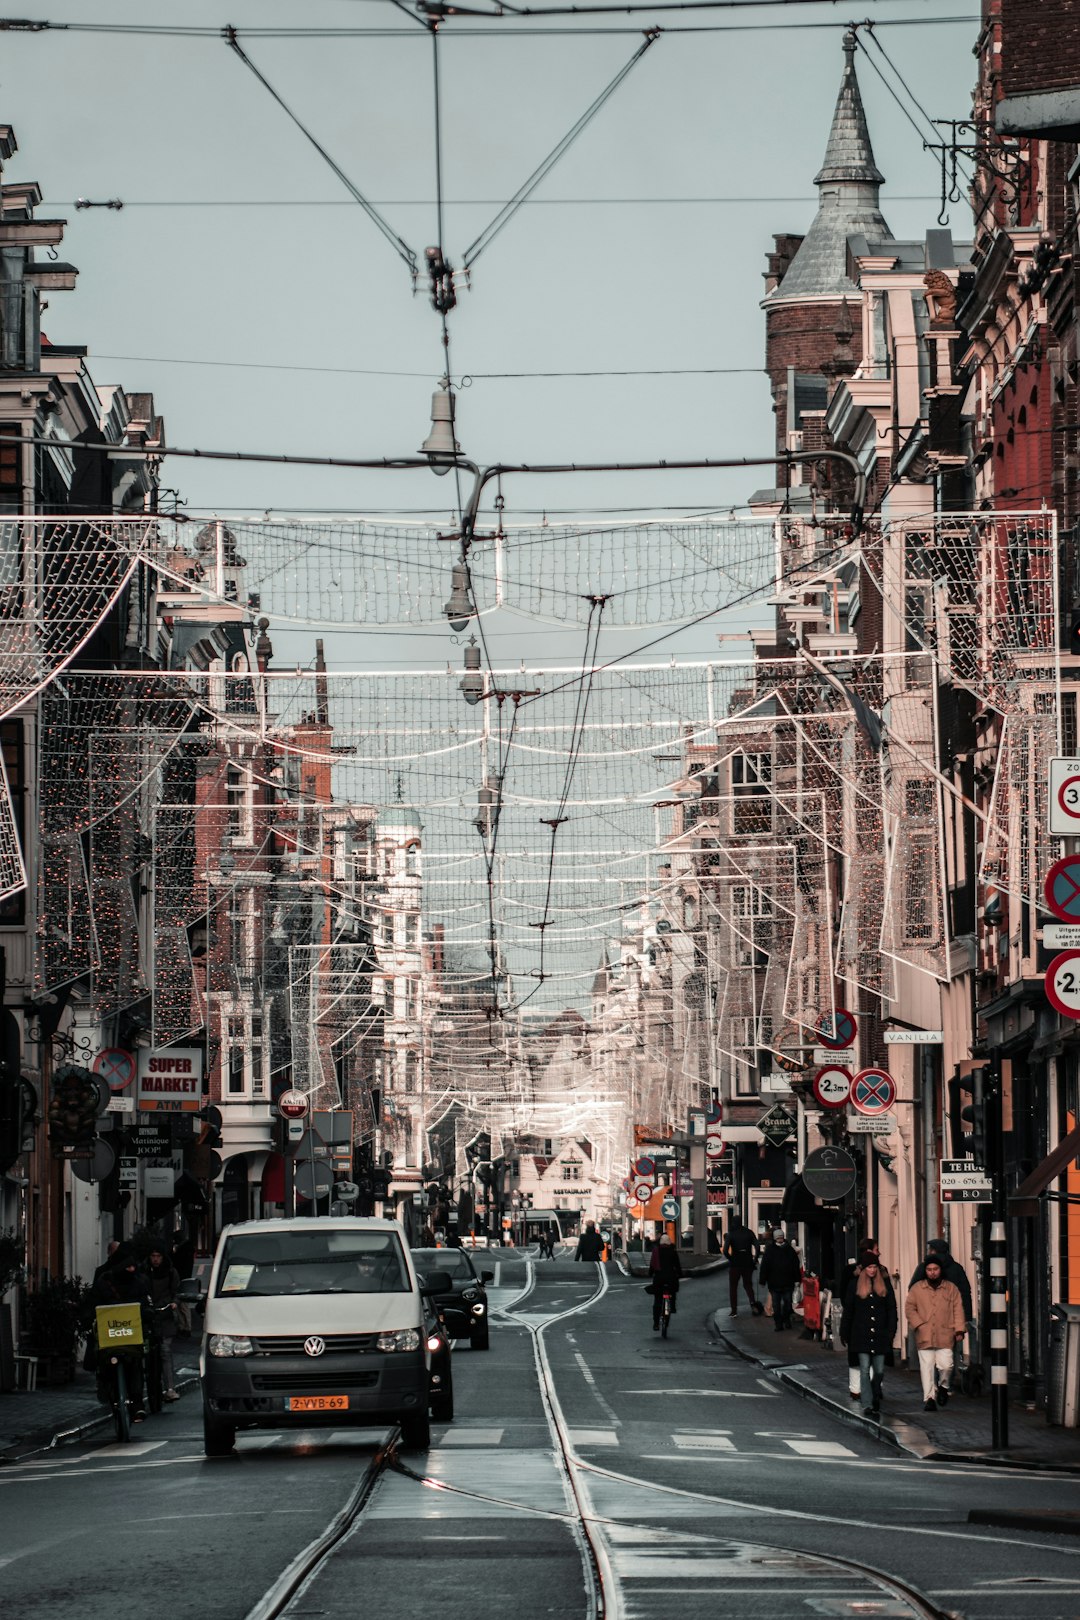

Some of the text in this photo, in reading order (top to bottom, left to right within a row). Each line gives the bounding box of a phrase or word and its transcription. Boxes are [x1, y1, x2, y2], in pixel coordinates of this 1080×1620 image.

[1067, 789, 1078, 804] 3
[149, 1058, 192, 1073] SUPER
[141, 1077, 198, 1092] MARKET
[823, 1080, 844, 1093] 2,3m
[156, 1101, 183, 1110] ATM
[764, 1116, 791, 1126] Brand
[131, 1137, 169, 1145] Matinique
[137, 1146, 161, 1155] JOOP!
[949, 1163, 962, 1171] TE
[707, 1189, 727, 1203] hotel
[108, 1320, 131, 1328] Uber
[108, 1328, 133, 1337] Eats
[293, 1398, 344, 1409] 2-VVB-69
